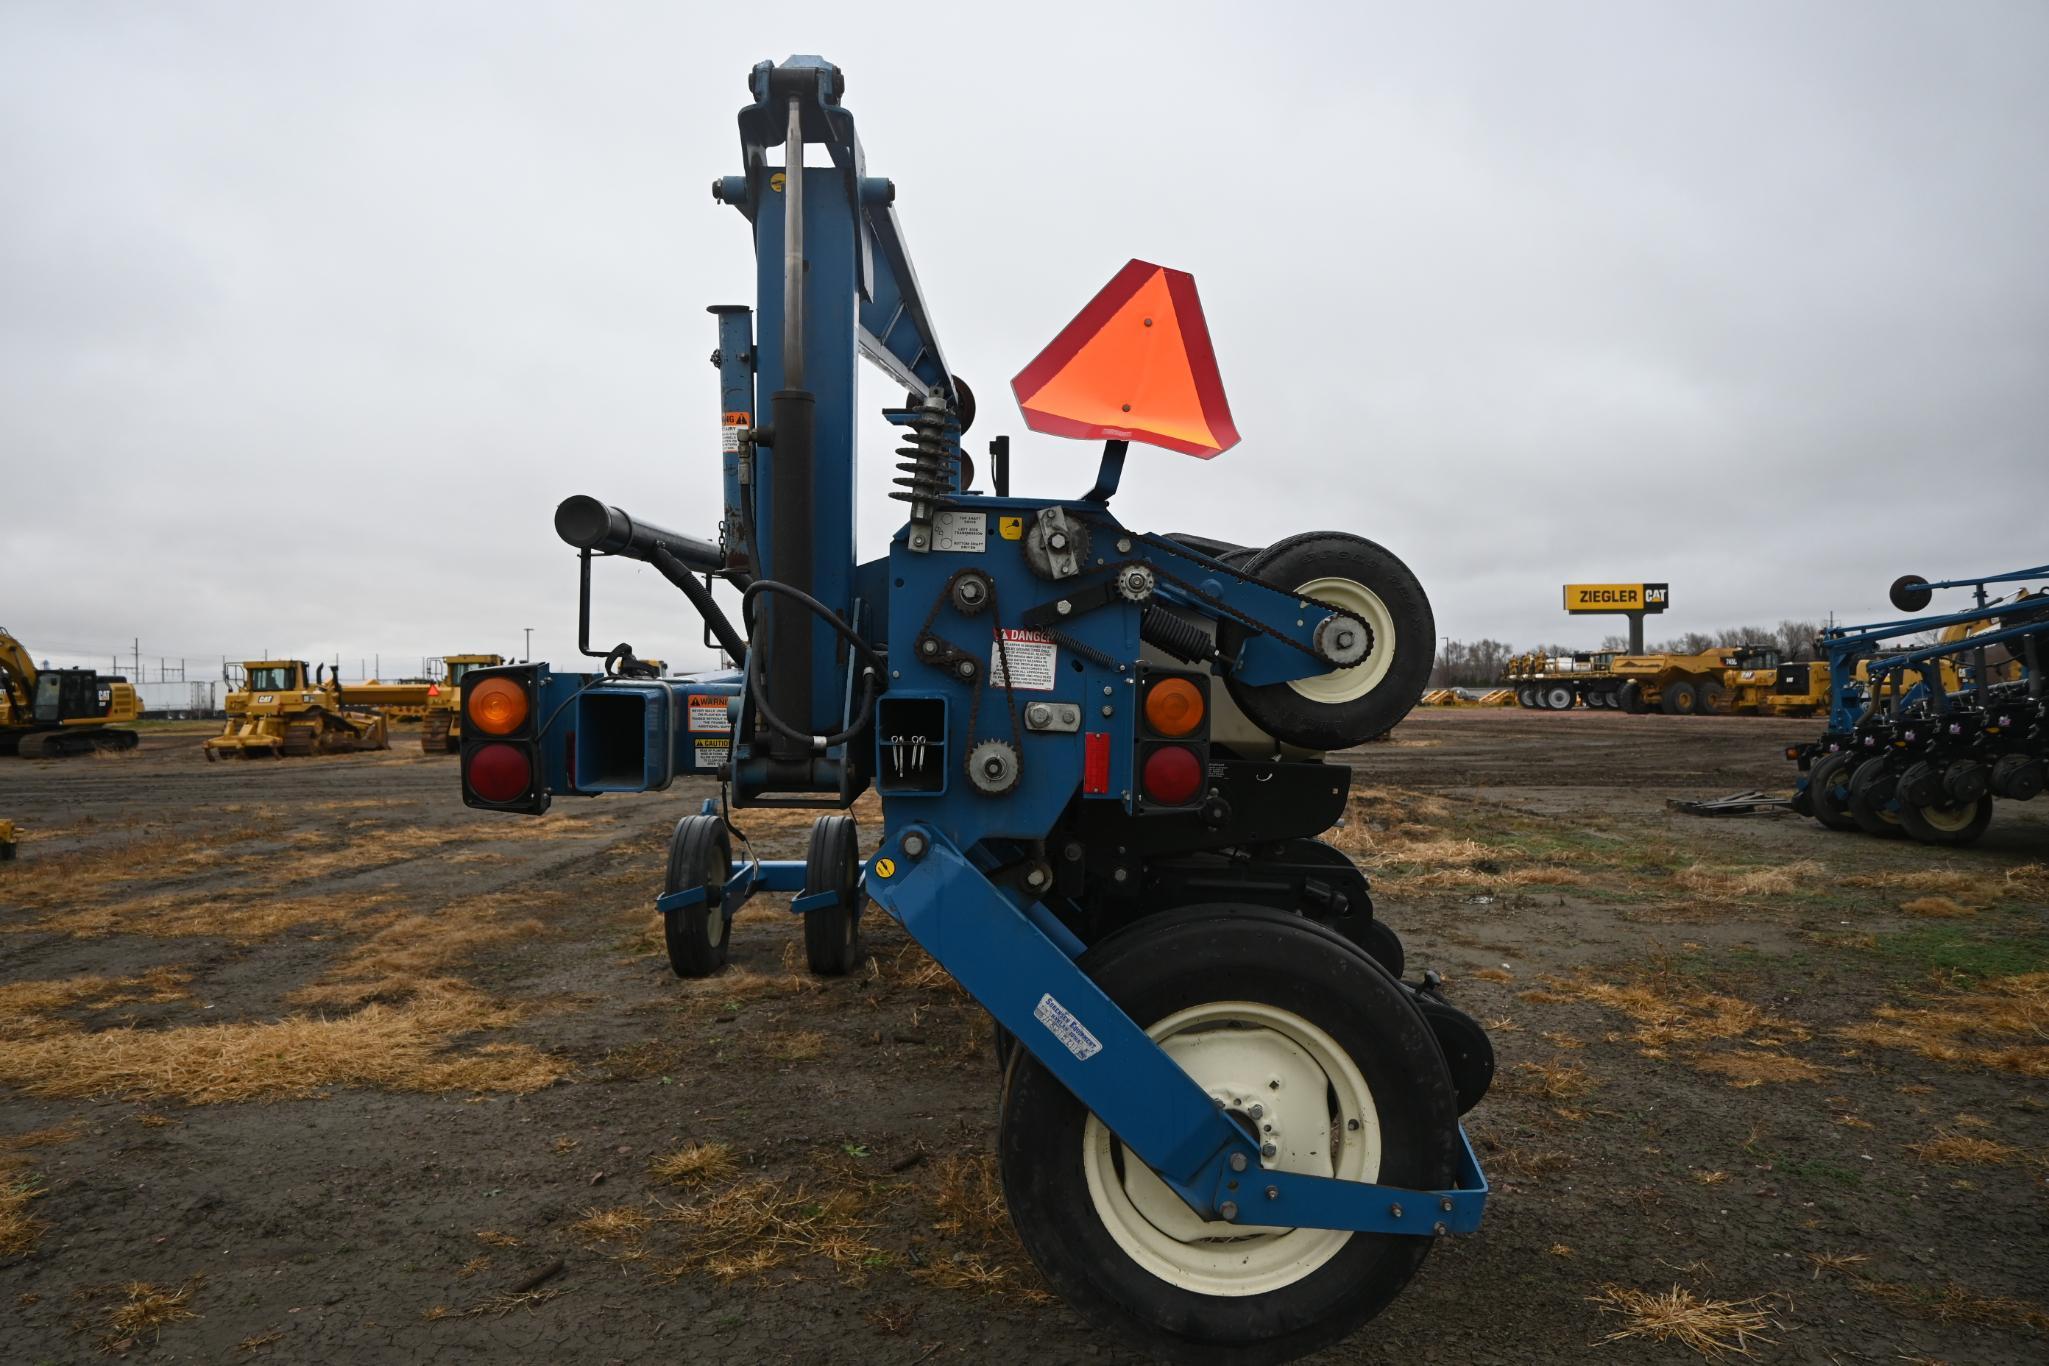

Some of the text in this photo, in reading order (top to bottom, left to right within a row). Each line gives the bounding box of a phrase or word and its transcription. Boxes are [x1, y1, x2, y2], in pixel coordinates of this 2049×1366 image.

[1580, 589, 1666, 603] ZIEGLER CAT
[1011, 629, 1052, 642] DANGE
[701, 697, 729, 706] WARNI
